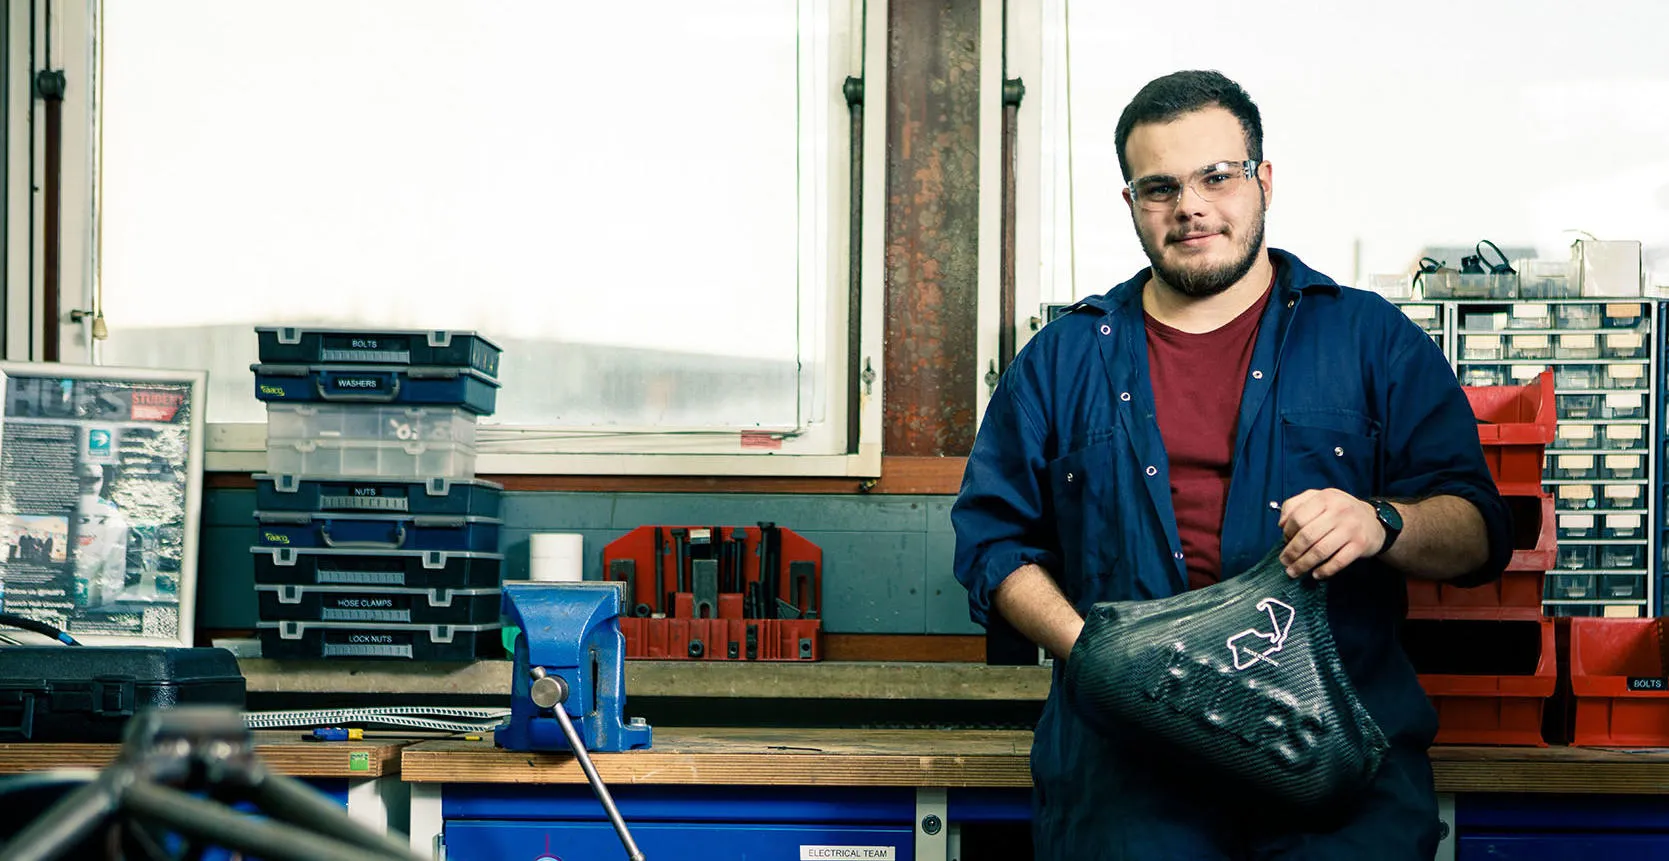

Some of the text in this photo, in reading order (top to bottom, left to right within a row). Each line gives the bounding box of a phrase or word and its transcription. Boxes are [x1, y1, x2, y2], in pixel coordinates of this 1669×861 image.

[352, 338, 377, 348] BOLTS
[338, 379, 377, 388] WASHERS
[354, 488, 376, 496] NUTS
[337, 599, 393, 607] HOSE CLAMPS
[348, 635, 393, 643] LOCK NUTS
[1633, 679, 1662, 689] BOLTS
[808, 848, 887, 857] ELECTRICAL TEAM
